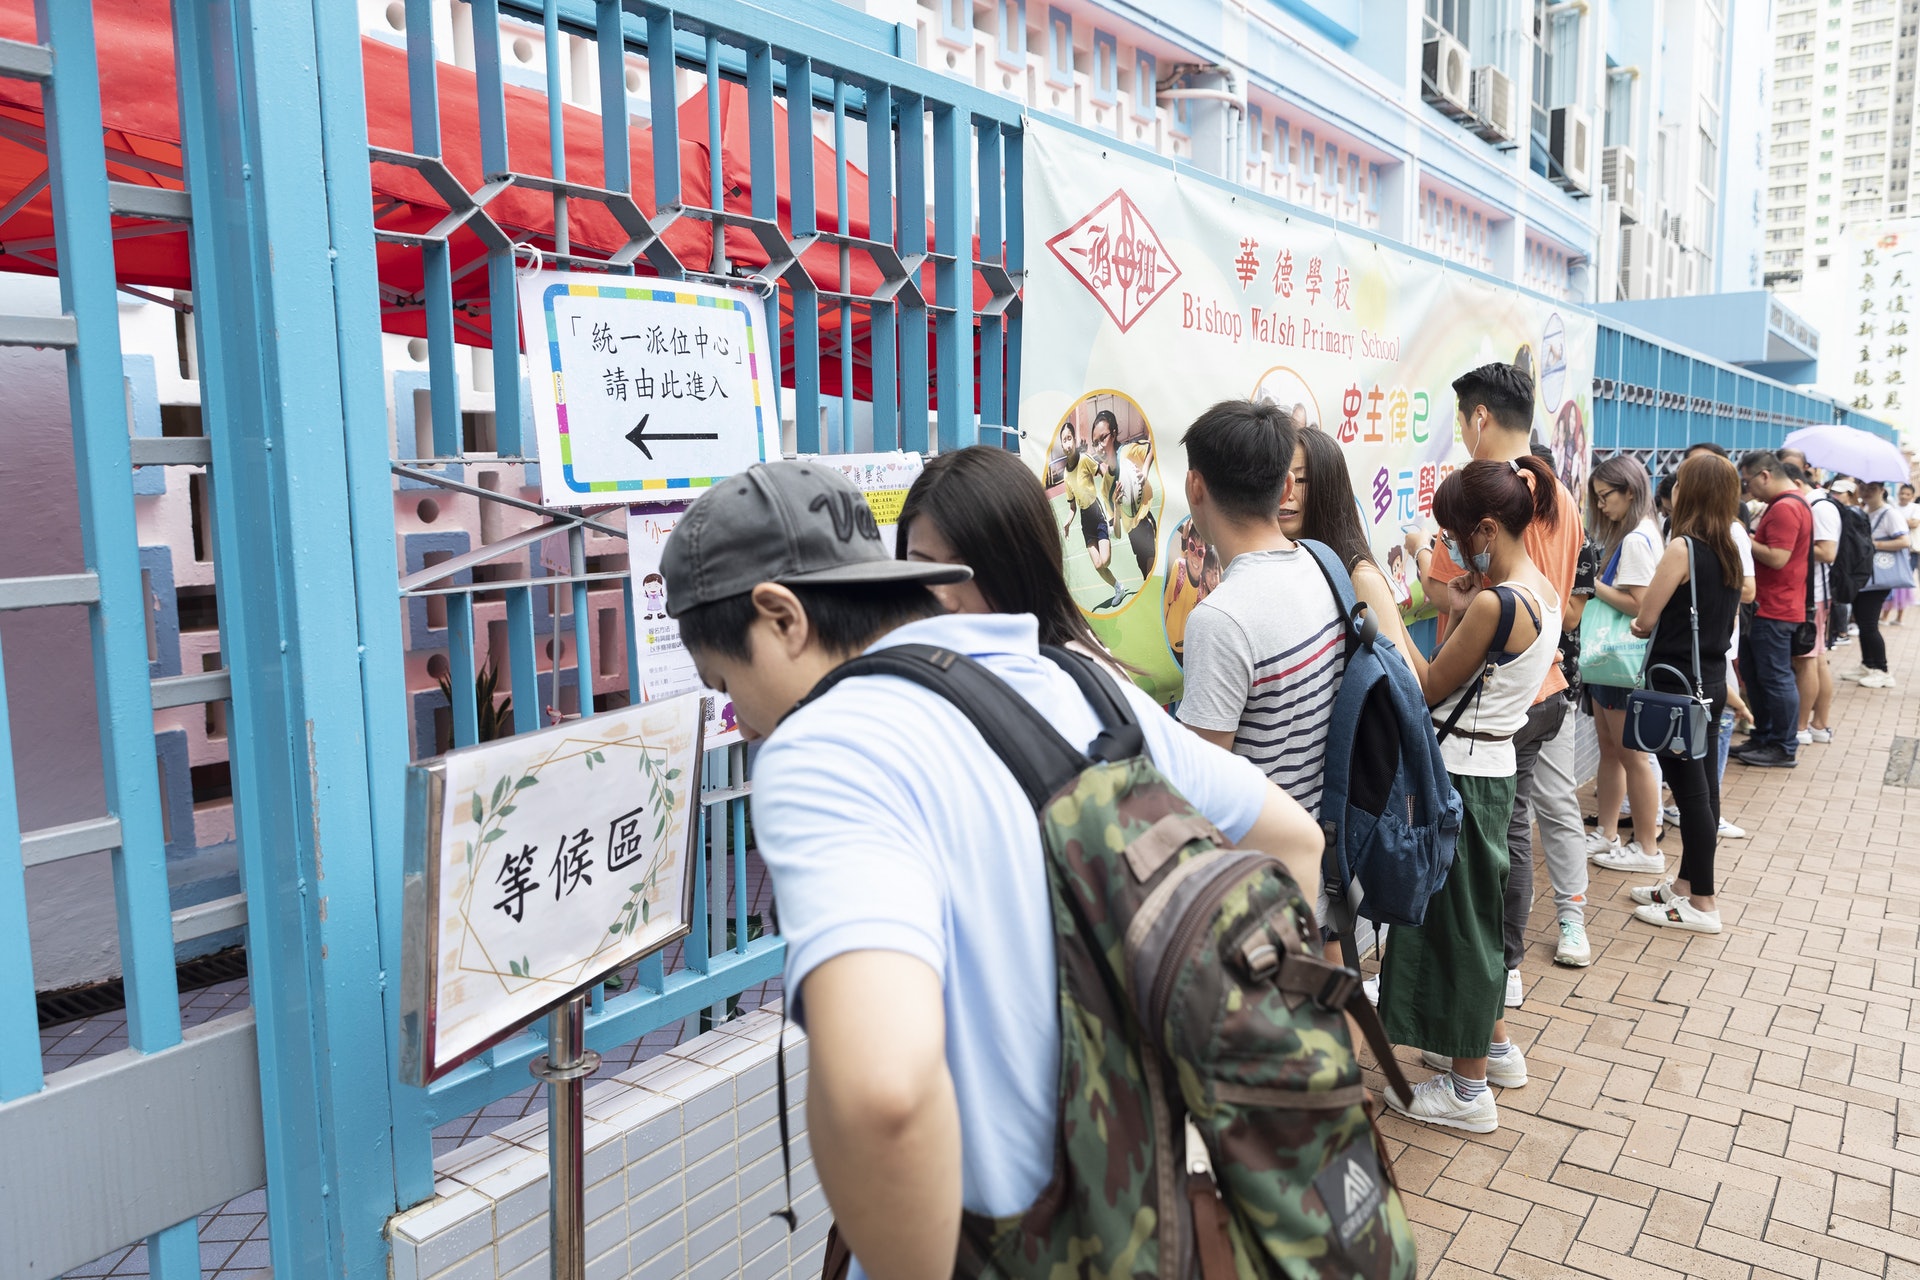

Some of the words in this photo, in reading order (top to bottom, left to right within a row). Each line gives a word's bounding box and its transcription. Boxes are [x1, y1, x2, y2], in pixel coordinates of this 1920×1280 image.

[1235, 237, 1351, 310] 華德學校
[571, 315, 742, 365] 「統一派位中心」
[1183, 292, 1242, 343] Bishop
[1251, 306, 1295, 347] Walsh
[1302, 318, 1354, 360] Primary
[1361, 329, 1400, 362] School
[602, 367, 728, 402] 請由此進入
[1336, 382, 1429, 443] 忠主律己
[1372, 465, 1455, 524] 多元學
[493, 806, 645, 924] 等候區
